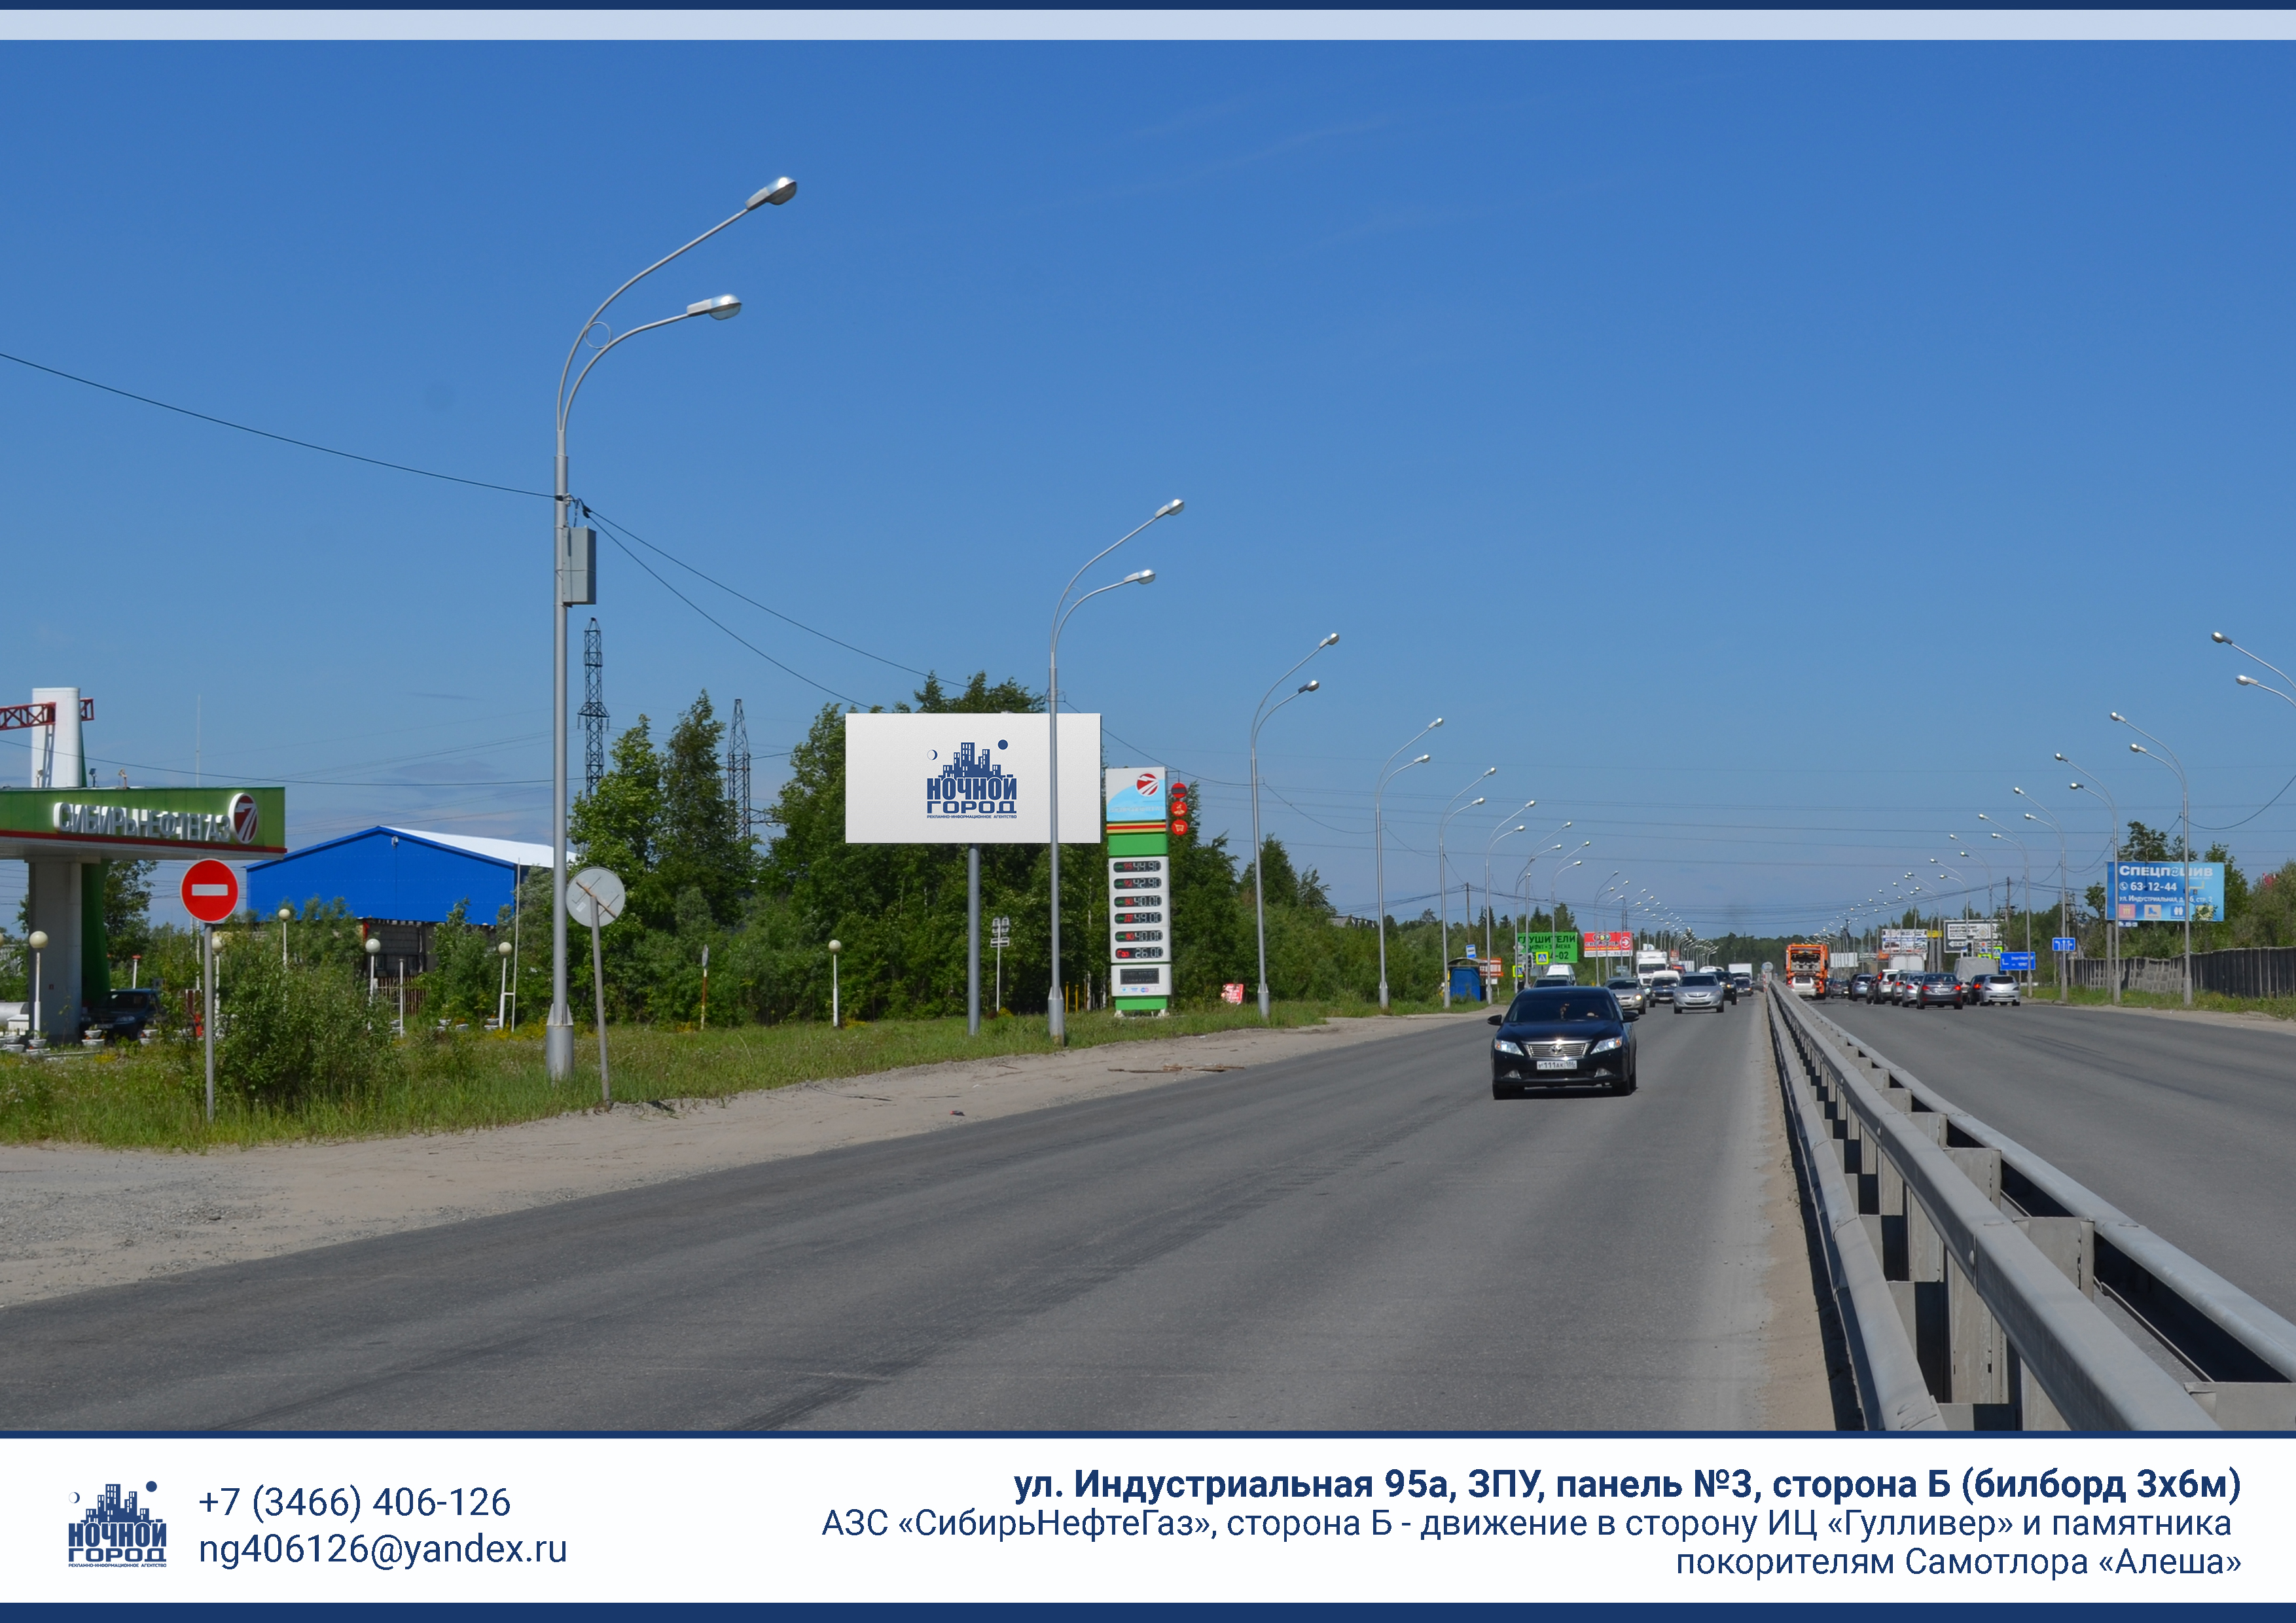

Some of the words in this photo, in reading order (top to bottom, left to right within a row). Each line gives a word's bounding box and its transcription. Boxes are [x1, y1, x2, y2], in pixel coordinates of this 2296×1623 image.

[927, 774, 1017, 800] НОЧНОЙ
[927, 801, 1017, 813] ГОРОД
[54, 802, 230, 842] СИБИРЬНЕФТЕГАЗ
[2130, 882, 2178, 891] 63-12-44
[1135, 948, 1163, 959] 26.00
